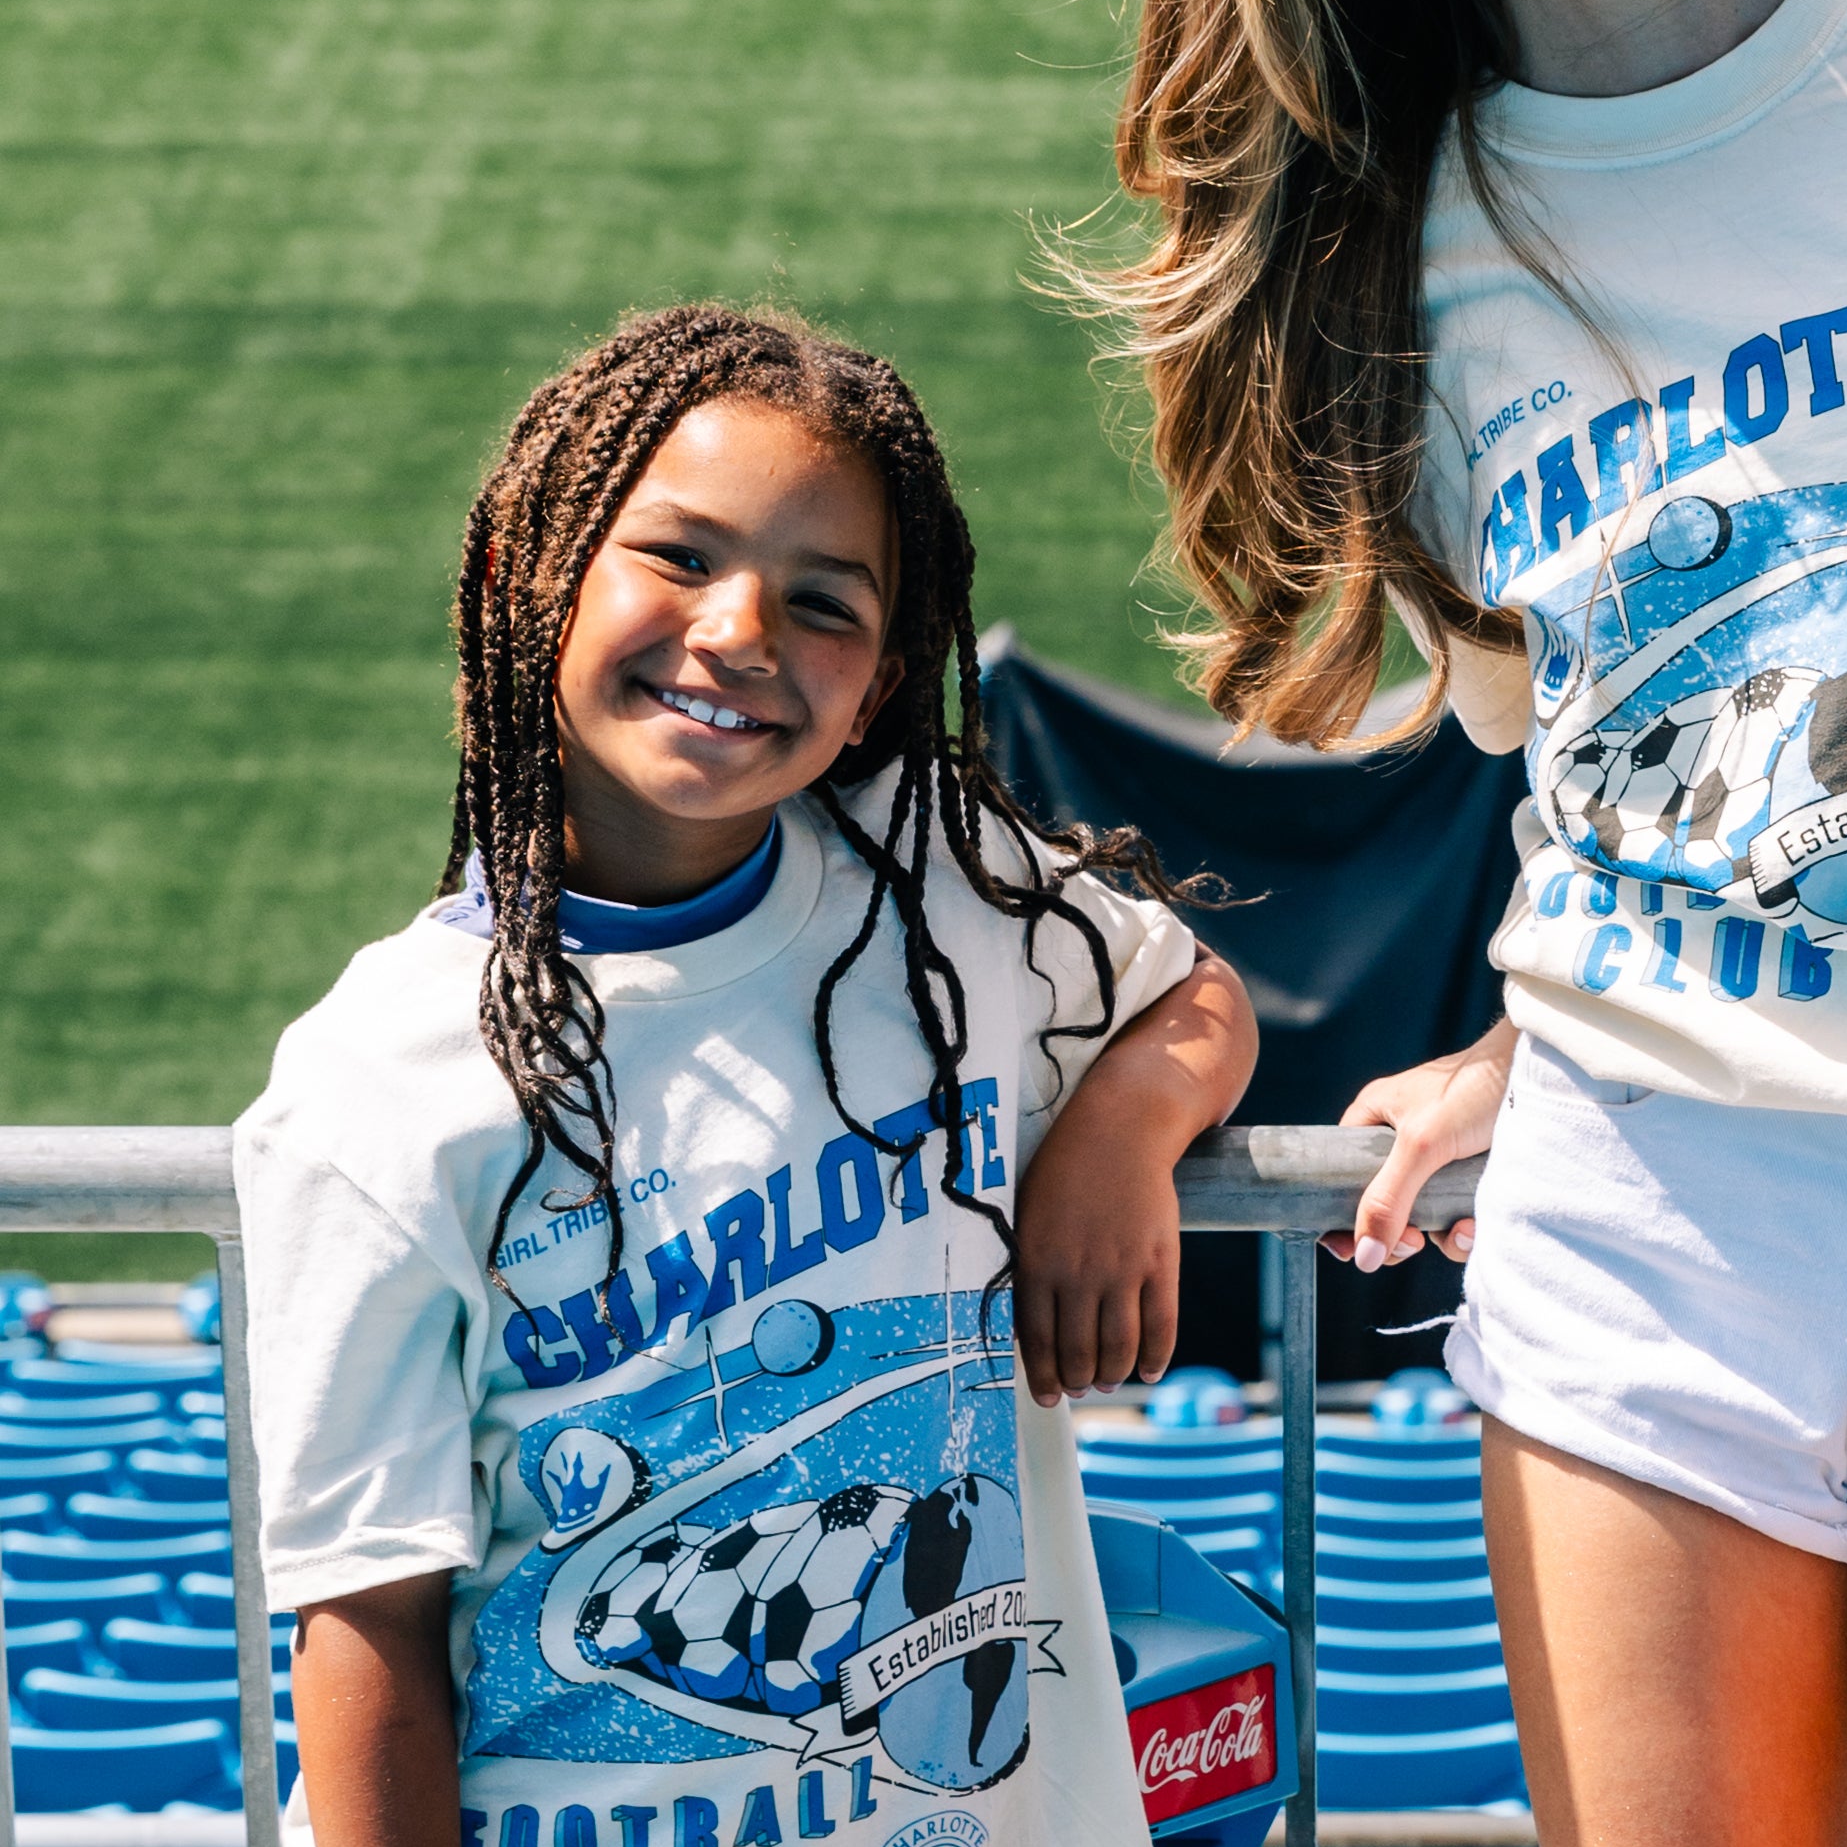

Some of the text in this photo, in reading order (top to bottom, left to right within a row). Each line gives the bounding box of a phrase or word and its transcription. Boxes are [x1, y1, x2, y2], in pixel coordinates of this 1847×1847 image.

[1479, 397, 1525, 450] TRIBE
[1531, 380, 1573, 413] CO.
[1572, 915, 1834, 1002] CLUB
[630, 1168, 677, 1203] CO.
[502, 1077, 1006, 1389] CHARLOTTE
[868, 1592, 997, 1693] Established
[1137, 1693, 1267, 1794] Coca-Cola
